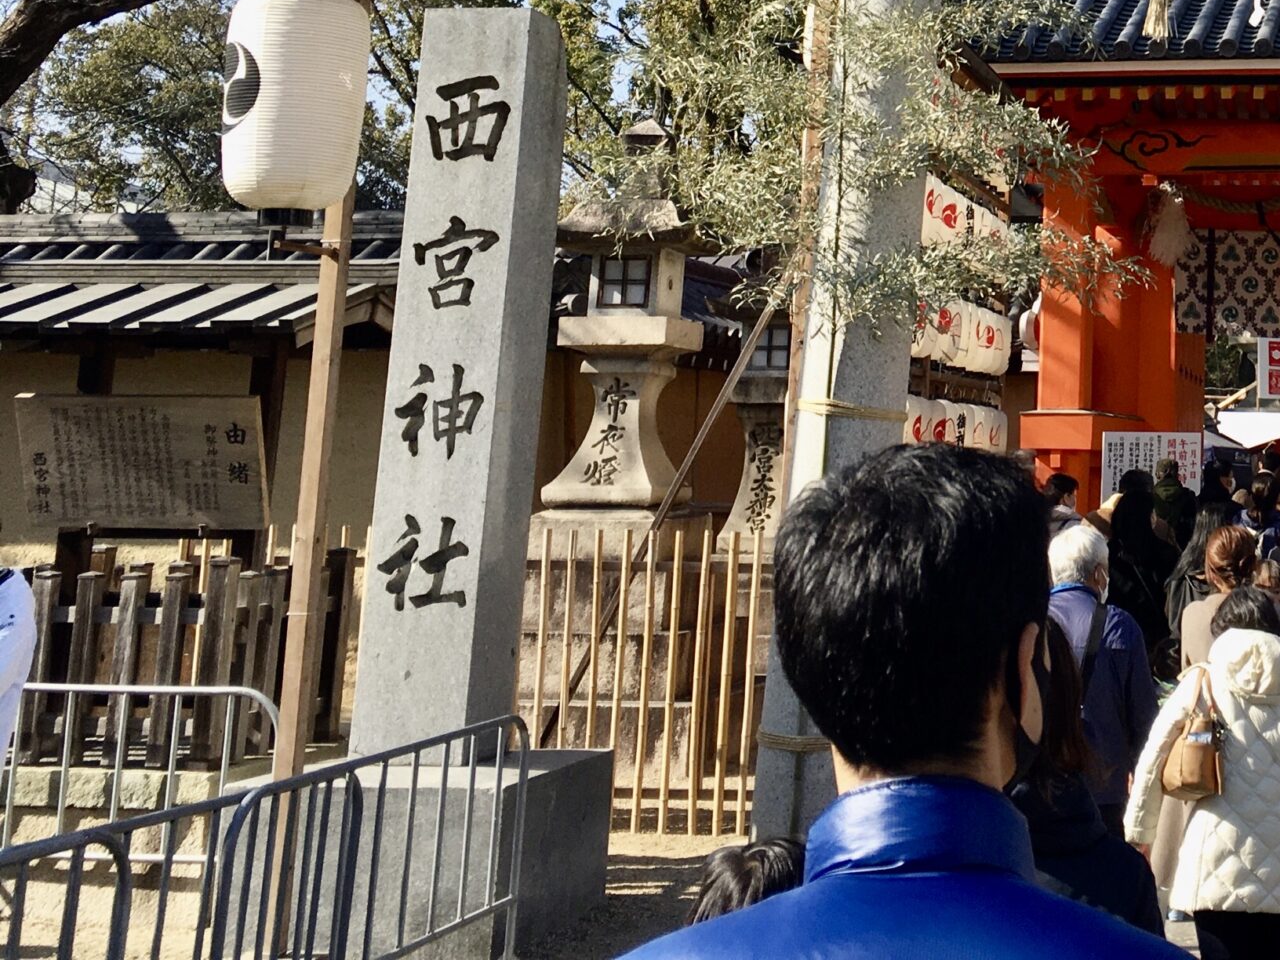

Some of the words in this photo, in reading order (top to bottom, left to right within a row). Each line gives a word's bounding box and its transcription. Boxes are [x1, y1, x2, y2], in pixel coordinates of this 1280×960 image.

[377, 75, 511, 611] 西宮神社
[32, 451, 52, 515] 西宮神社
[225, 422, 250, 485] 由緒
[1190, 441, 1198, 479] 一月十日
